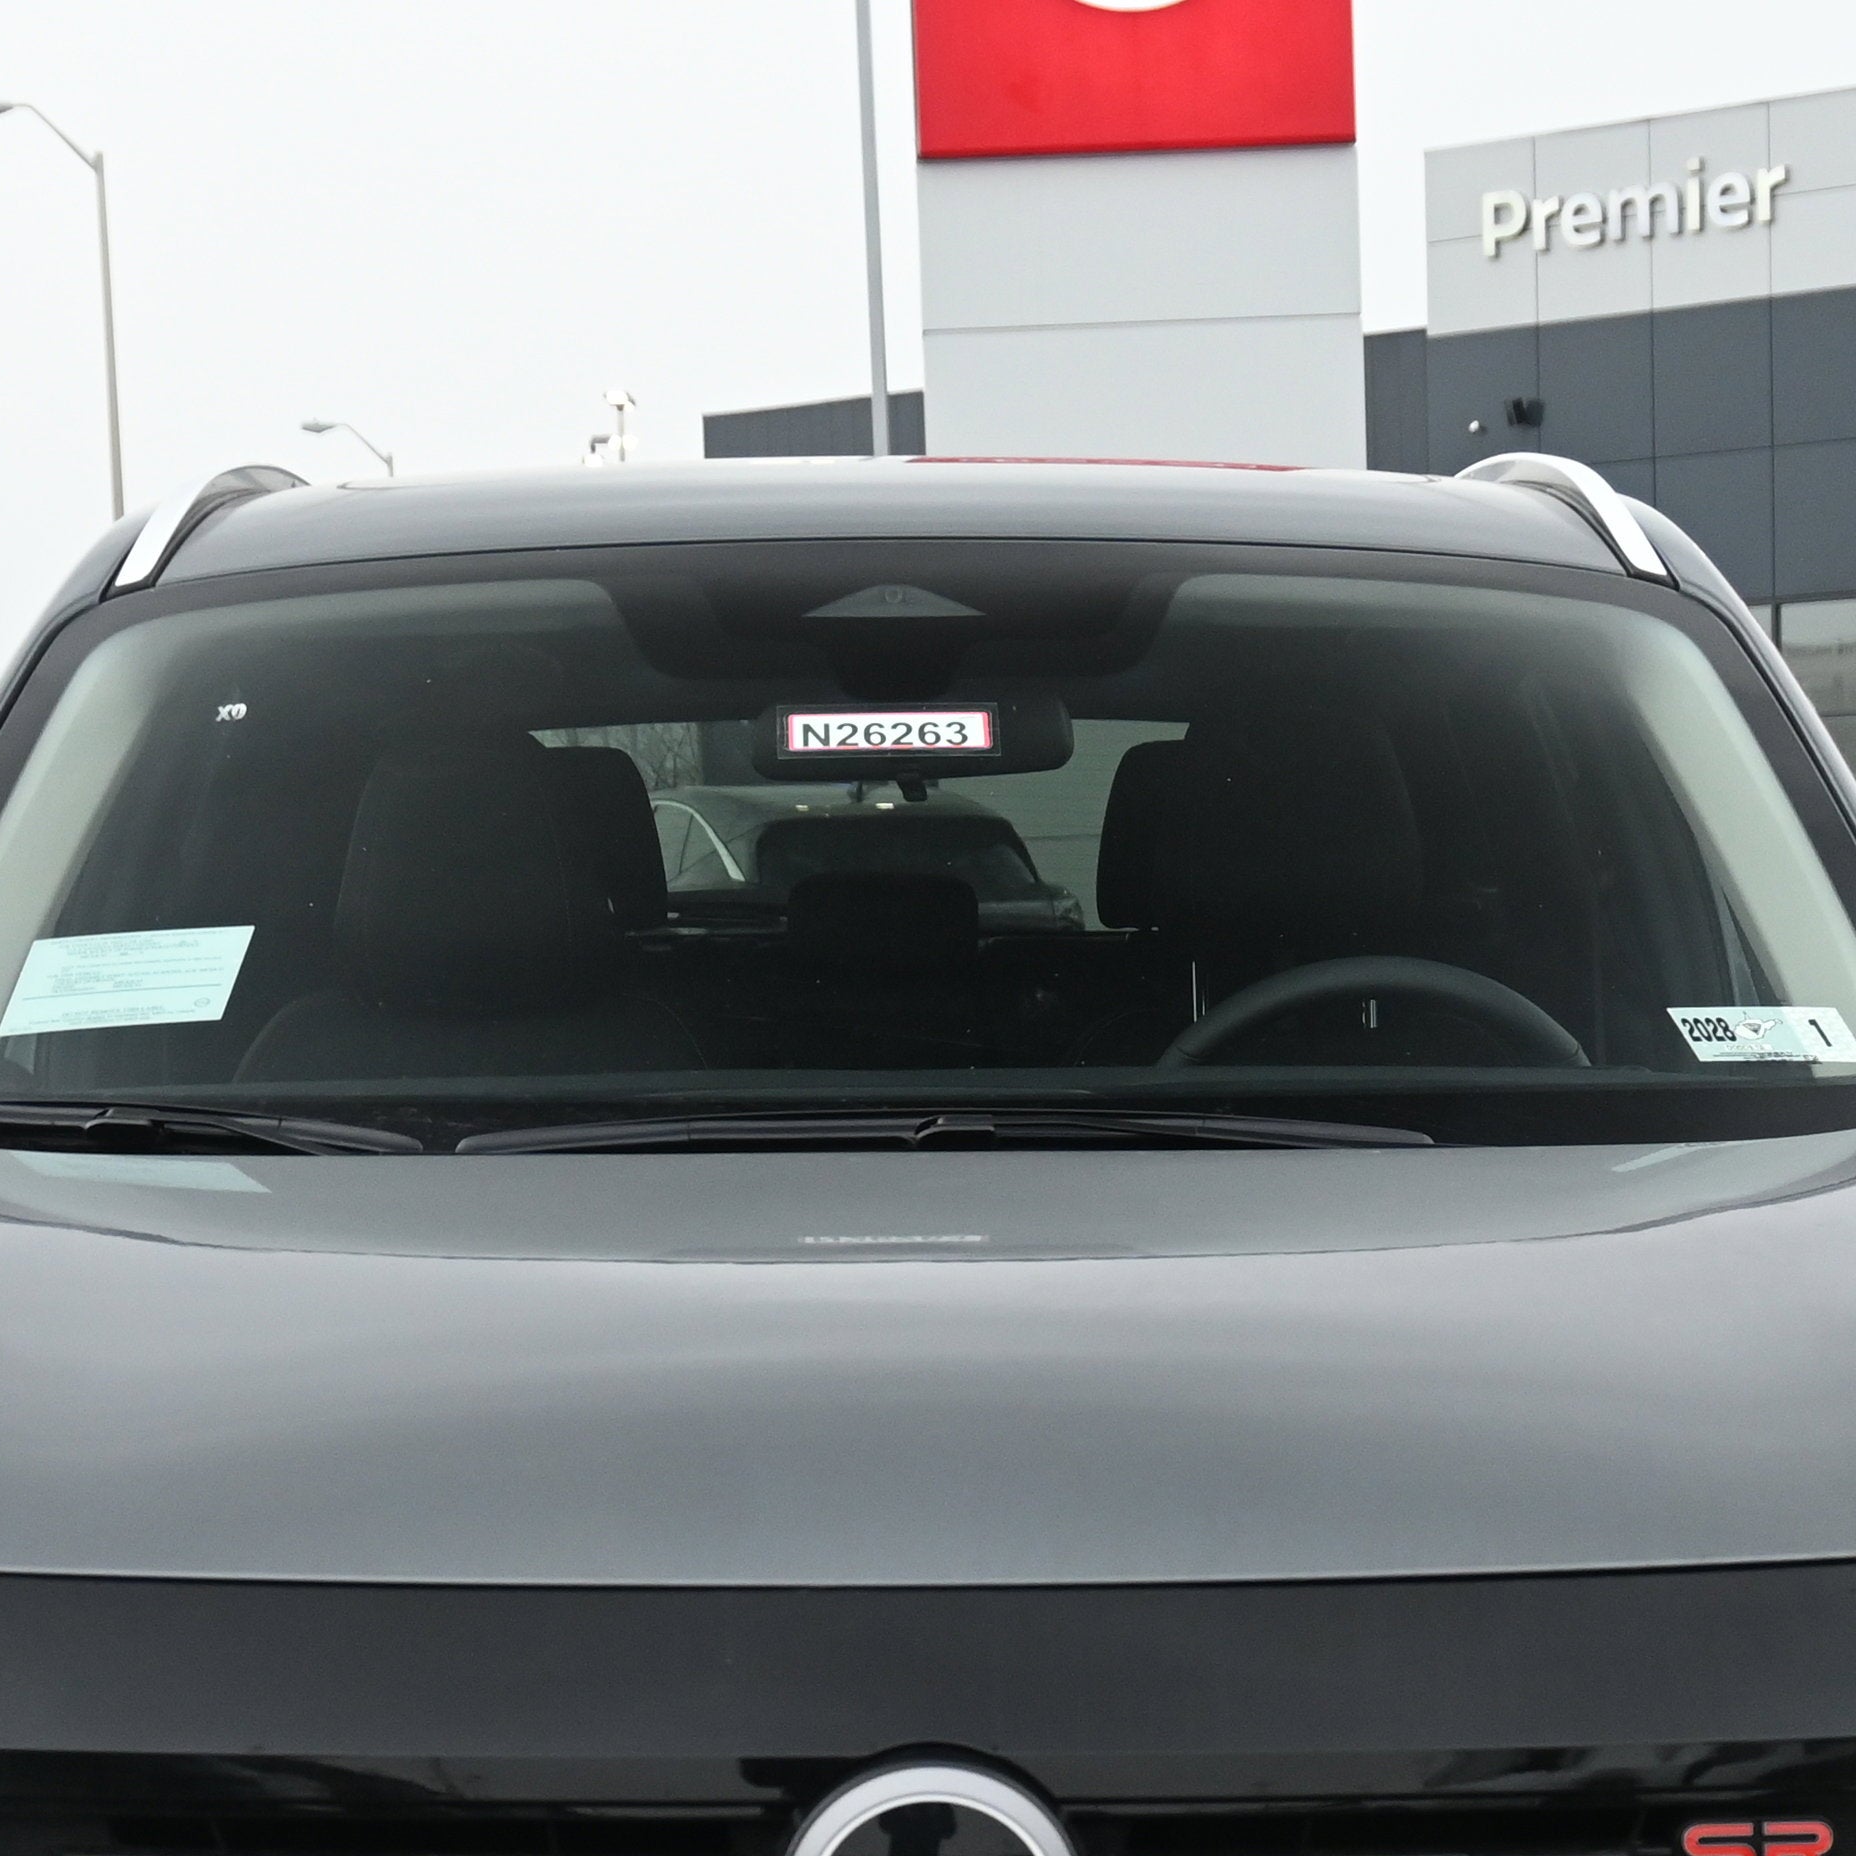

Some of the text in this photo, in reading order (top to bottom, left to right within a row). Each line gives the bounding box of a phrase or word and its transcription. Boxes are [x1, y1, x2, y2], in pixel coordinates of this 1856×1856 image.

[1482, 156, 1788, 257] Premier
[801, 721, 969, 748] N26263
[1681, 1017, 1737, 1042] 2028
[1808, 1019, 1832, 1047] 1
